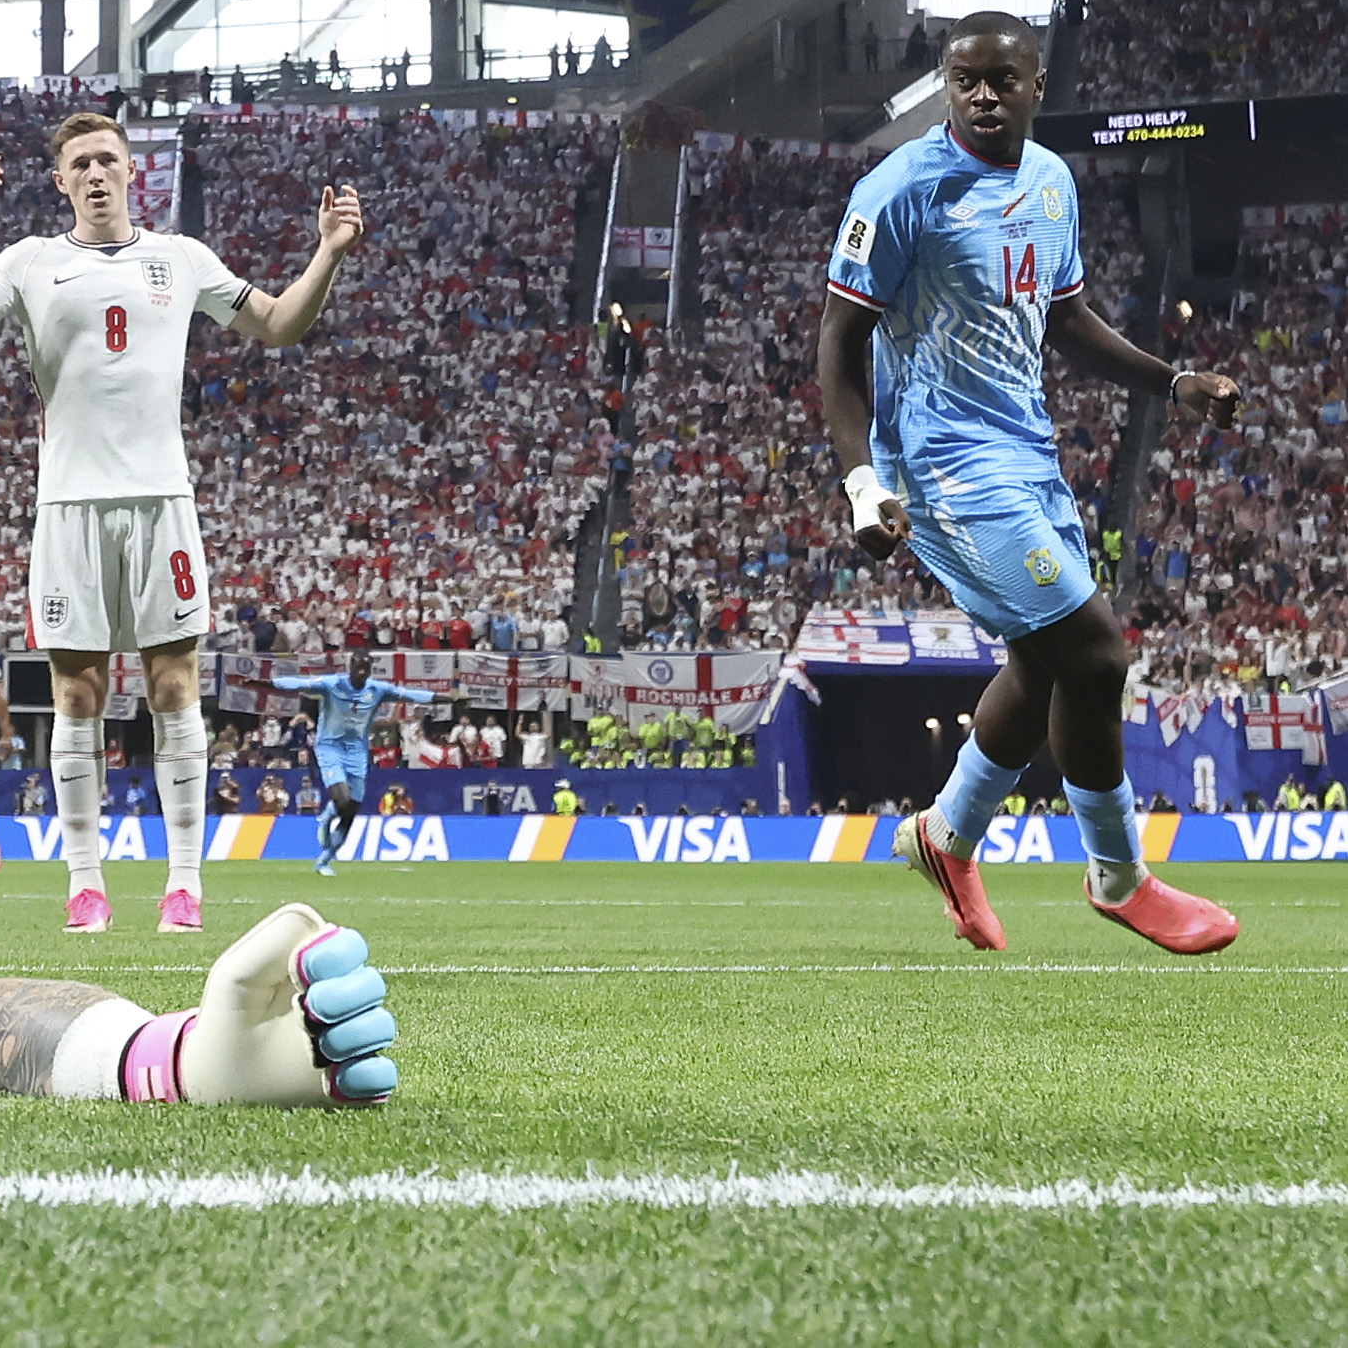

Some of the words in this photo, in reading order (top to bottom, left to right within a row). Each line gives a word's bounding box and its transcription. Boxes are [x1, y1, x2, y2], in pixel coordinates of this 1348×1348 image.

[1093, 131, 1124, 144] TEXT
[1127, 125, 1205, 141] 470-444-0234
[1108, 114, 1144, 128] NEED
[1145, 110, 1187, 126] HELP?
[1003, 243, 1037, 307] 14
[105, 305, 127, 352] 8
[169, 549, 196, 600] 8
[636, 688, 732, 705] ROCHDALE
[463, 785, 537, 813] FFA
[618, 817, 751, 863] VISA
[1223, 813, 1348, 861] VISA
